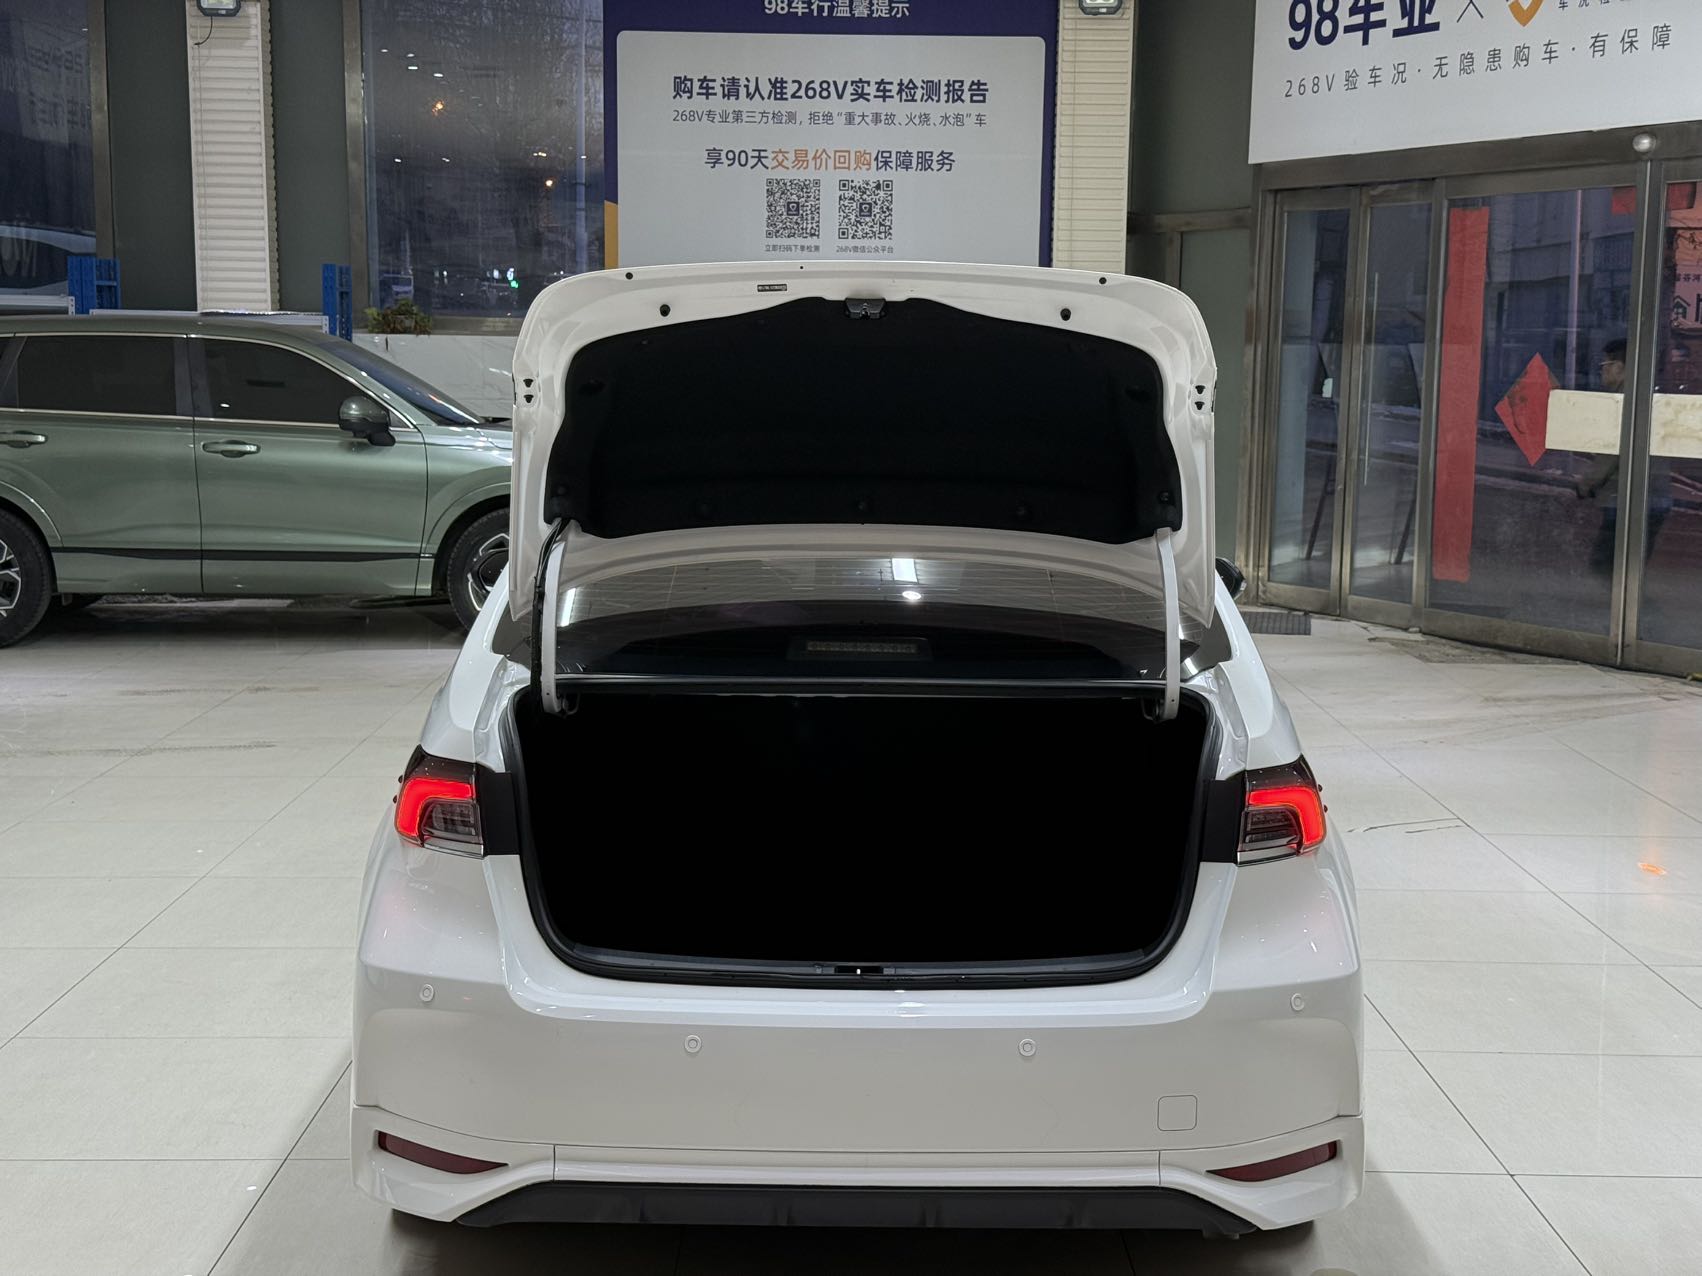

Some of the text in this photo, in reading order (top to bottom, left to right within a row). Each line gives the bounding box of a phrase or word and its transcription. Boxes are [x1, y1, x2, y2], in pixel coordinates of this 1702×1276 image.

[763, 0, 910, 17] 98车行温馨提示
[672, 75, 990, 104] 购车请认准268V实车检测报告
[704, 148, 956, 172] 享90天交易价回购保障服务
